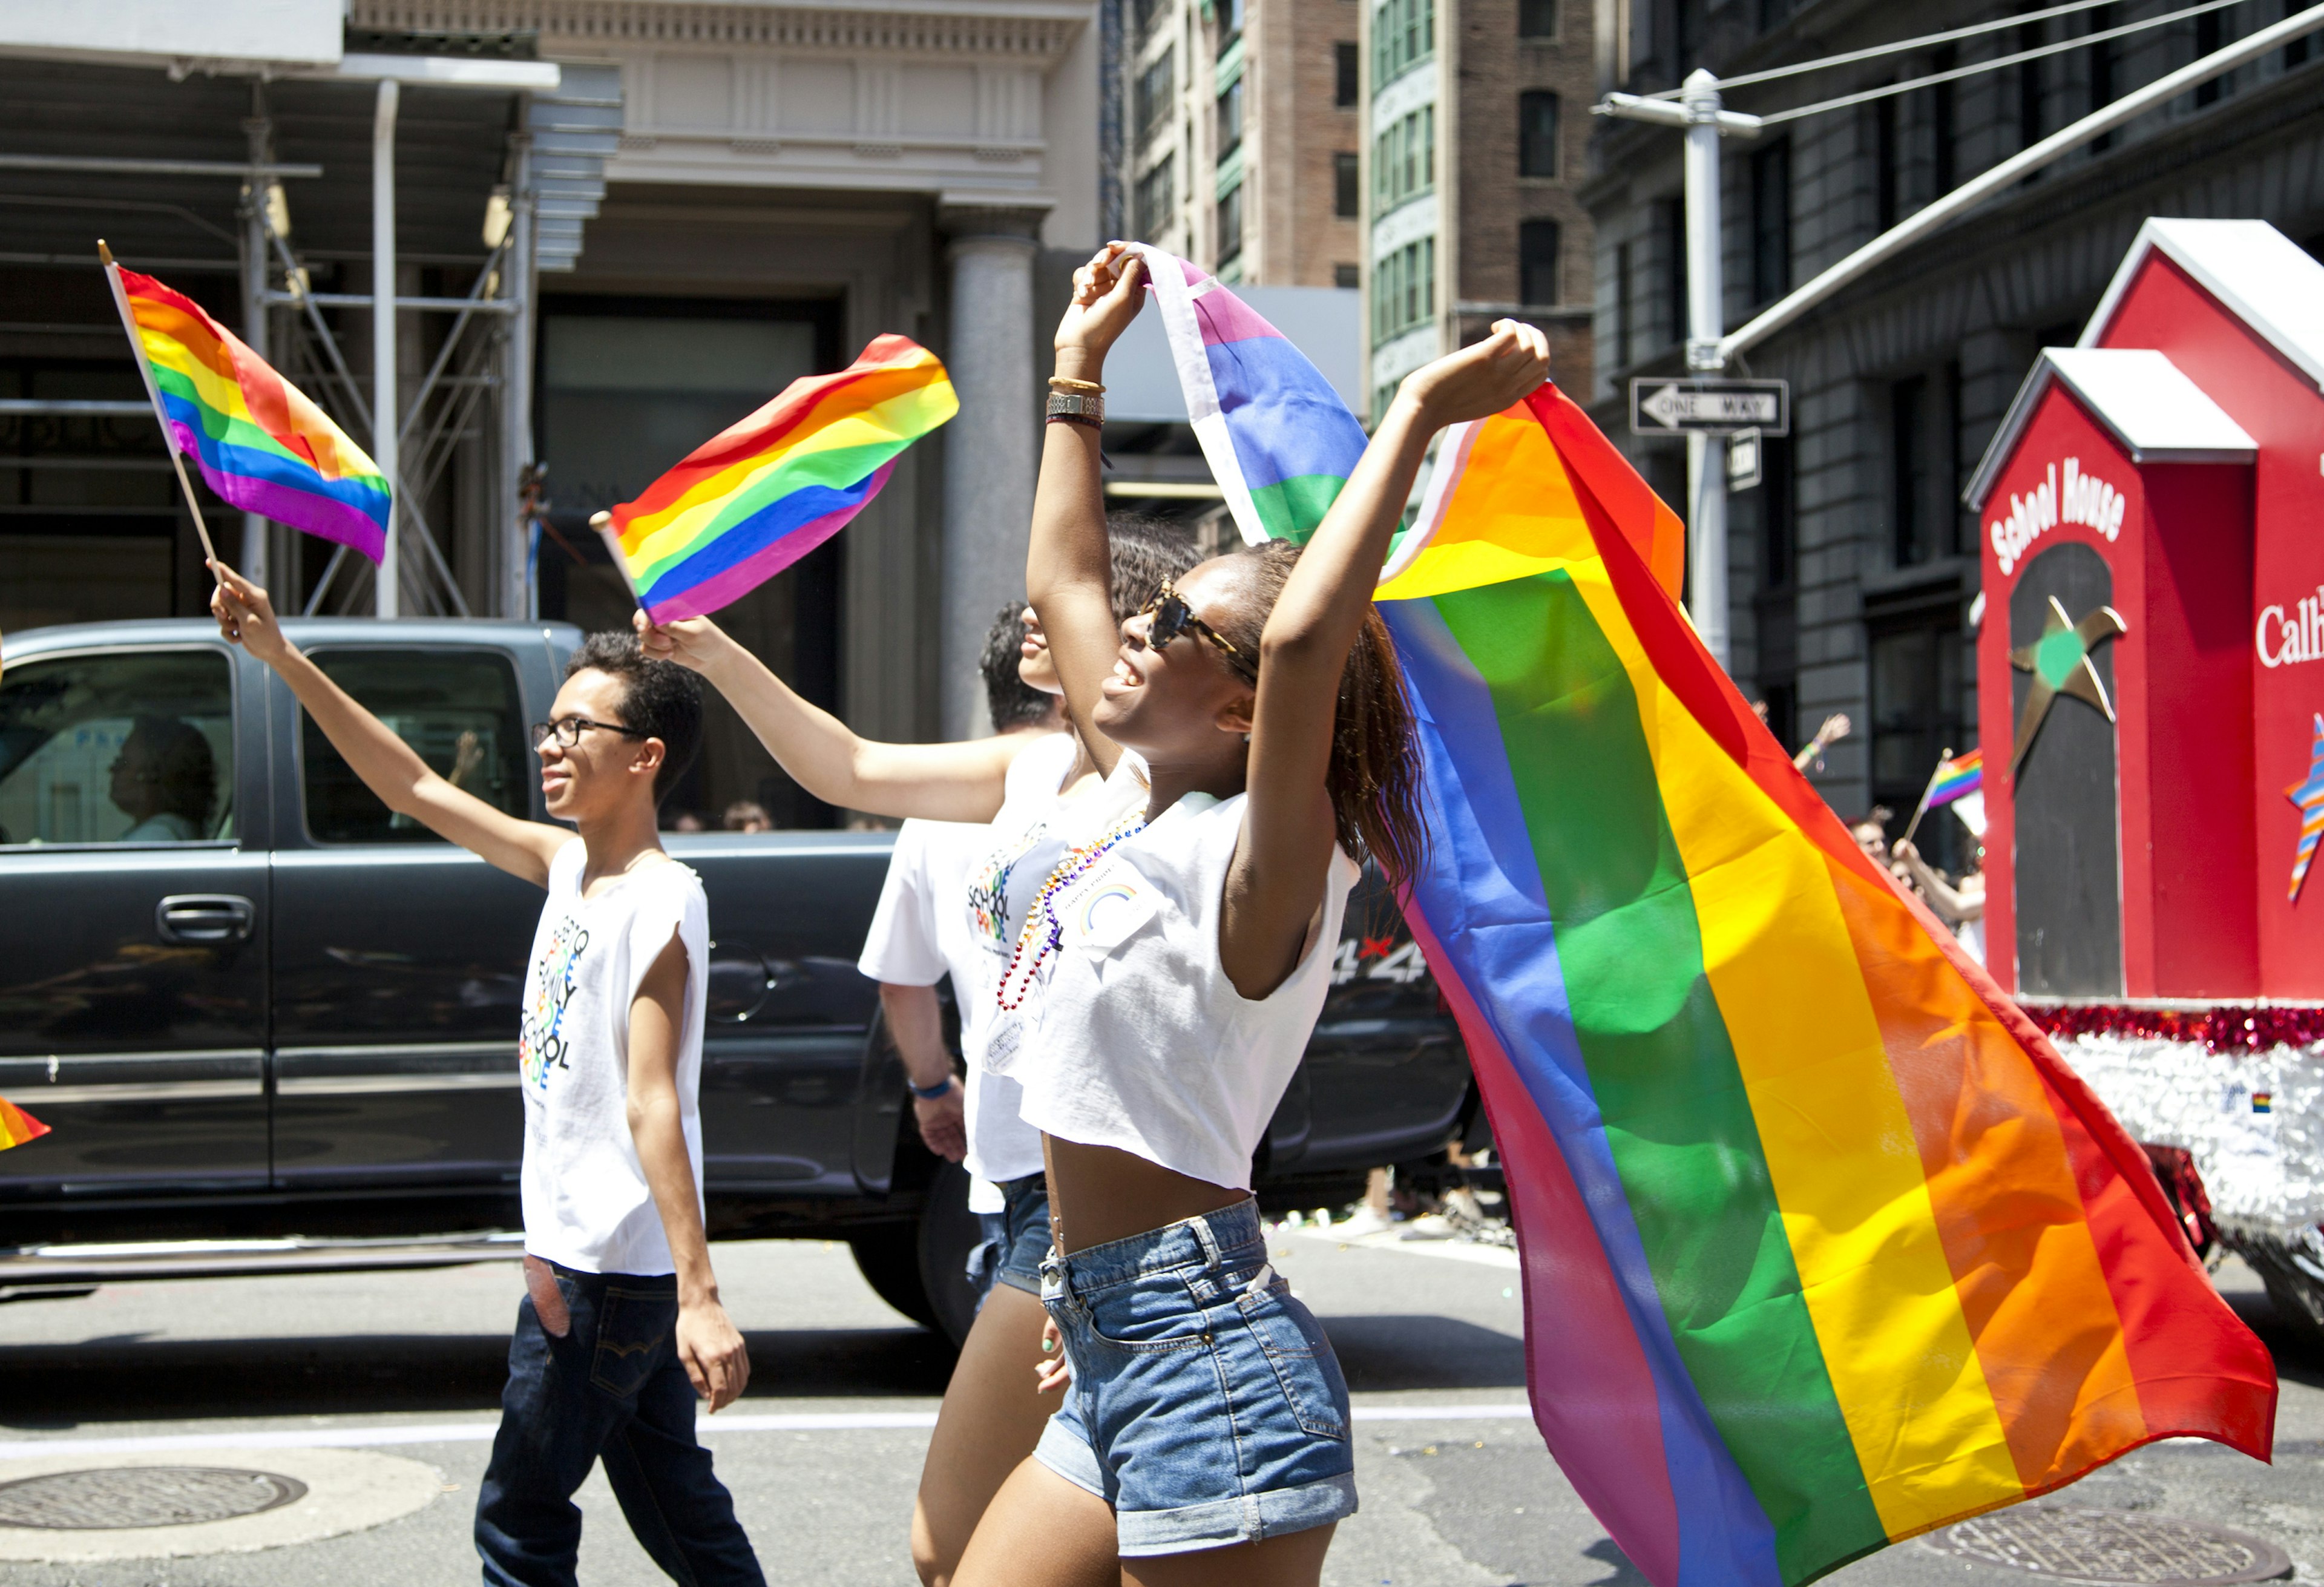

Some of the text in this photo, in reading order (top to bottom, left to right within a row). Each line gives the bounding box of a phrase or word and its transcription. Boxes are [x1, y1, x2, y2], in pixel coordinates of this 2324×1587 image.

[1660, 396, 1765, 415] ONE WAY
[1991, 456, 2125, 576] School House
[968, 885, 1010, 921] SCHOOL
[544, 938, 577, 982] PRDE
[519, 1040, 551, 1090] PRDE
